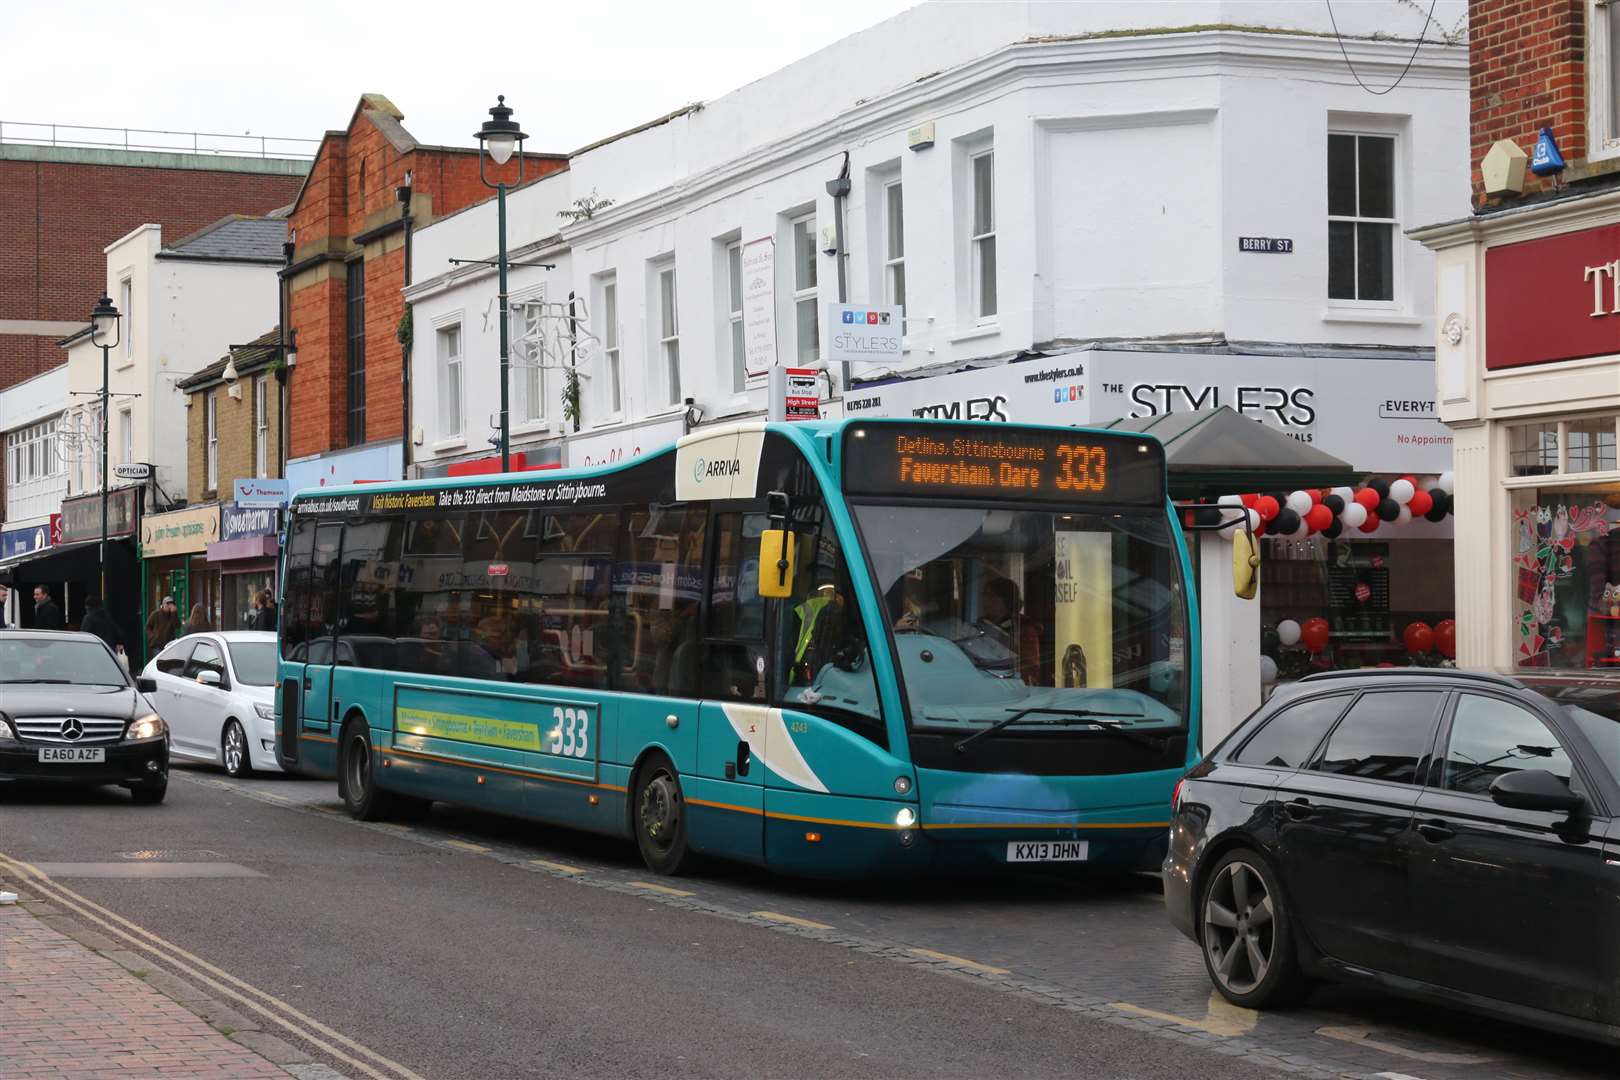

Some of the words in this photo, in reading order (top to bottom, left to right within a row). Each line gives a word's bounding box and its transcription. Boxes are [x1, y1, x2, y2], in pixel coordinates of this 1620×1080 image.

[1243, 239, 1271, 250] BERRY
[834, 336, 898, 350] STYLERS
[1103, 383, 1124, 392] THE
[1398, 435, 1410, 444] No
[118, 467, 148, 475] OPTICIAN
[705, 459, 740, 477] ARRIVA
[1055, 444, 1104, 491] 333
[372, 495, 384, 509] Visit
[384, 493, 404, 508] historic
[439, 490, 452, 506] Take
[453, 489, 463, 504] the
[464, 490, 475, 504] 333
[476, 488, 493, 504] direct
[494, 487, 510, 502] from
[511, 484, 546, 502] Maidstone
[547, 487, 556, 501] or
[551, 706, 588, 758] 333
[44, 749, 75, 760] EA60
[78, 749, 100, 760] AZF
[1016, 843, 1048, 860] KX13
[1052, 843, 1080, 859] DHN
